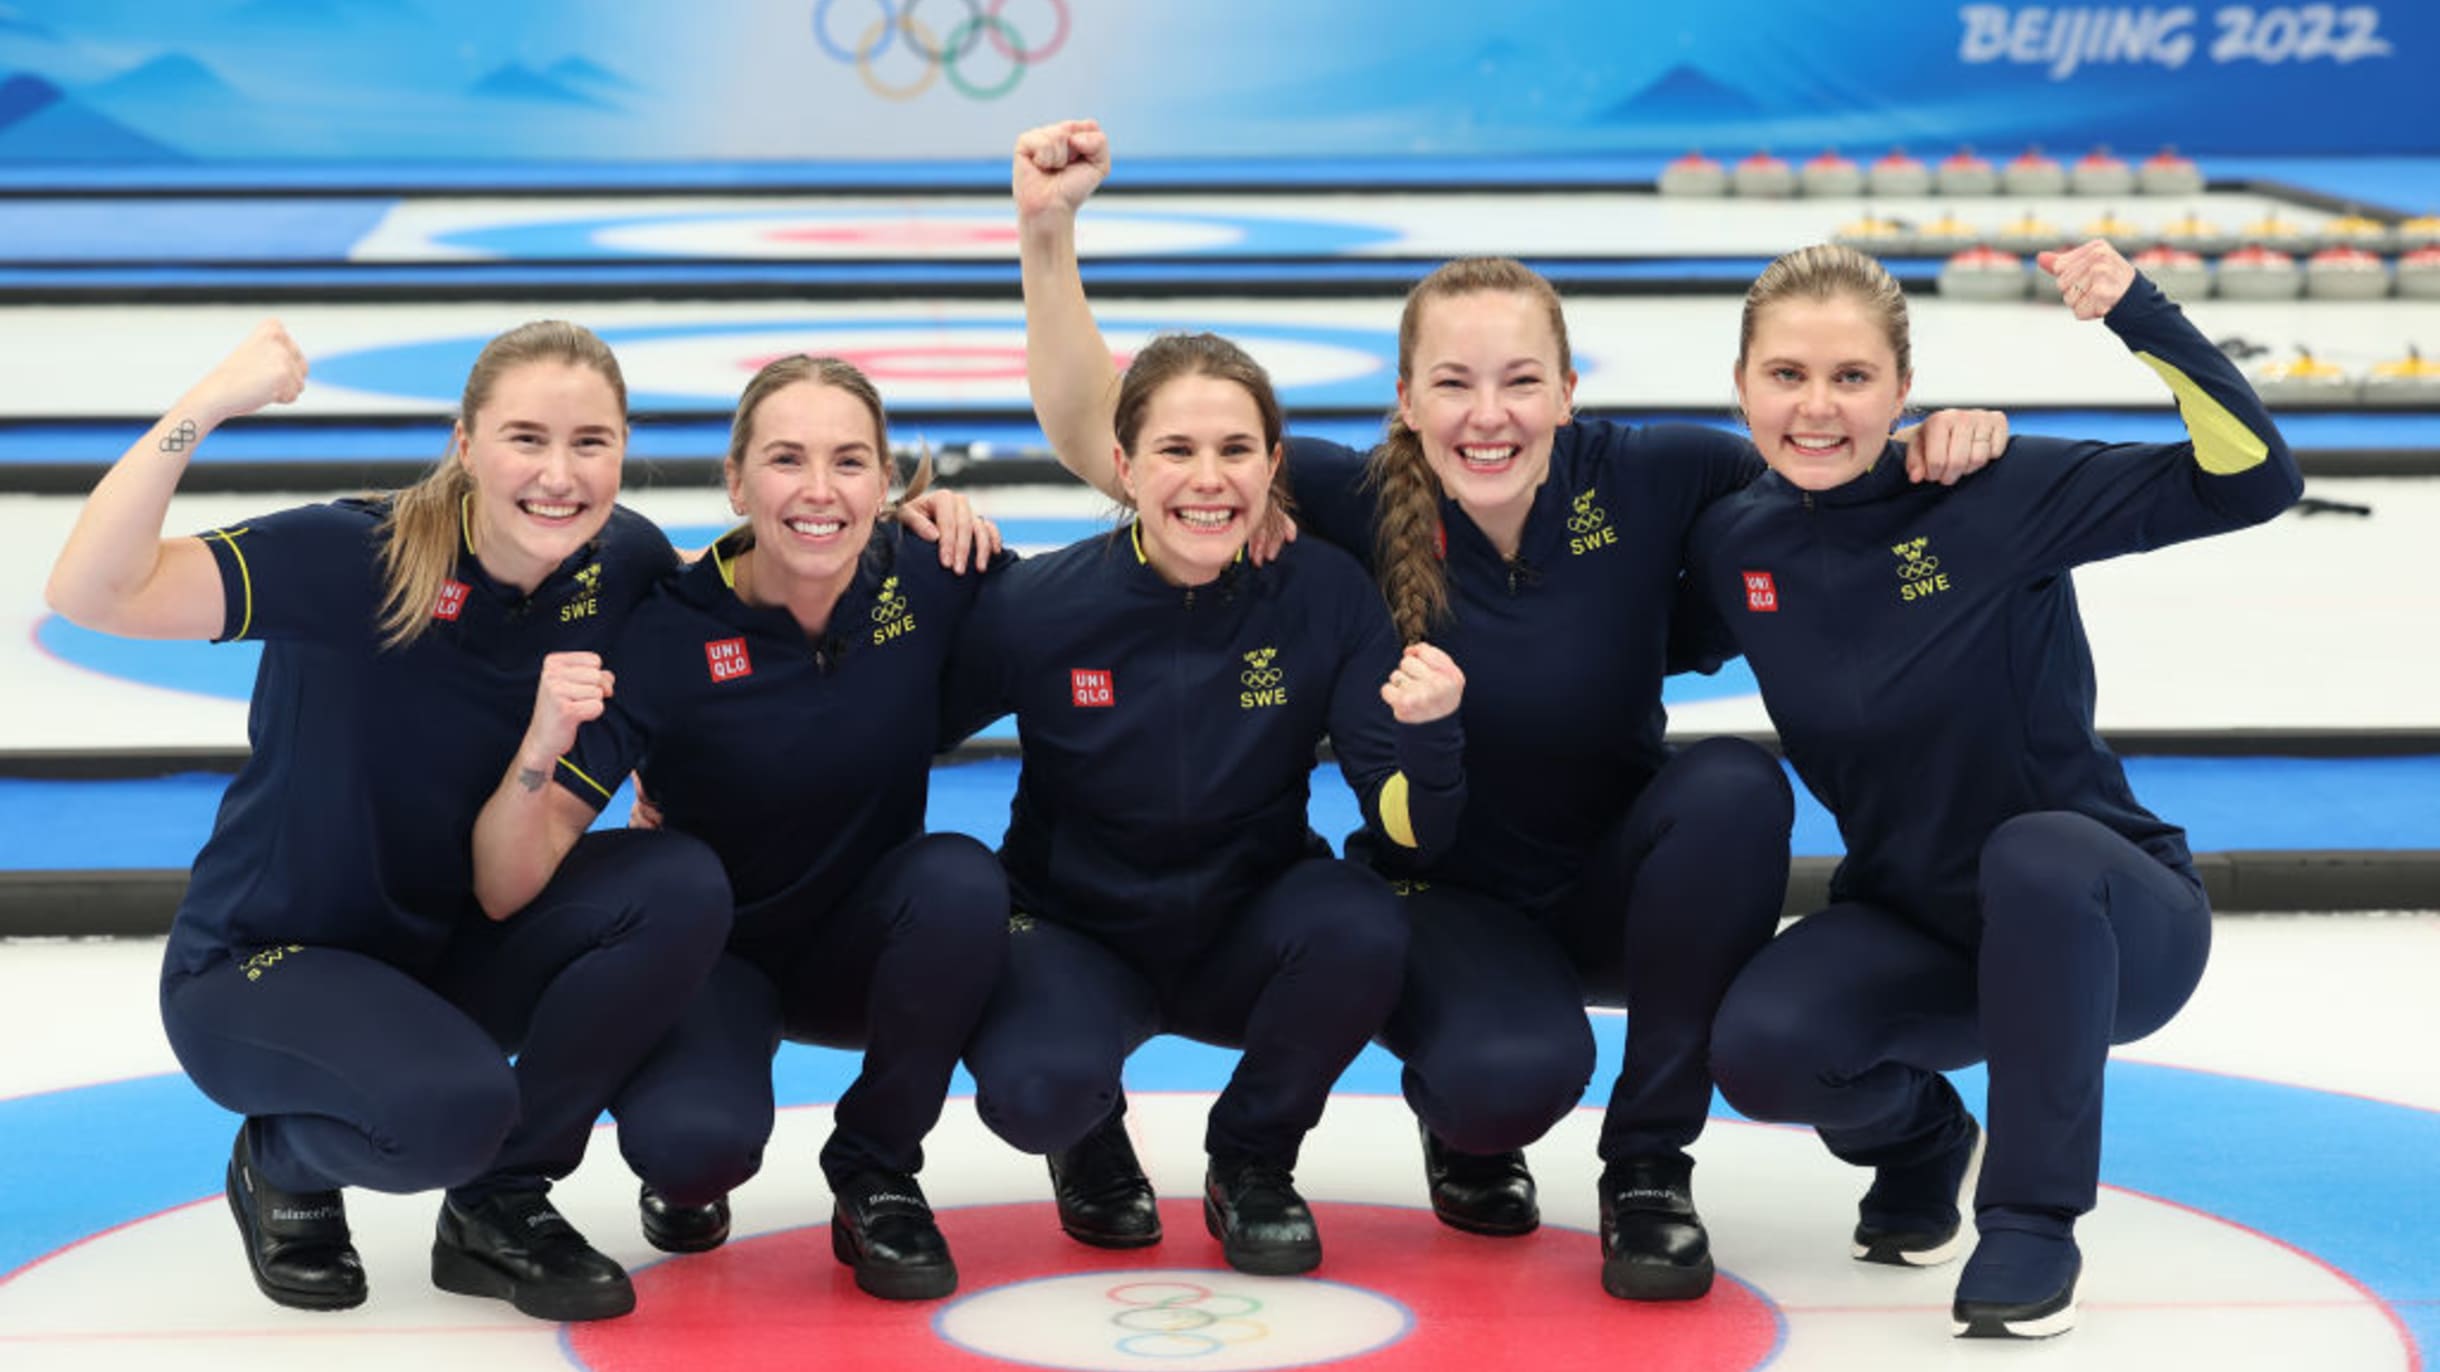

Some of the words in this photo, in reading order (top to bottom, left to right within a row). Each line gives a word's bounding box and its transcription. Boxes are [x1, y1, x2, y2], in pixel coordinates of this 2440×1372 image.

[1958, 5, 2196, 82] BEIJING
[2209, 5, 2395, 65] 2022
[1570, 526, 1618, 555] SWE
[1901, 573, 1950, 600] SWE
[437, 601, 457, 615] LO
[560, 599, 598, 622] SWE
[873, 614, 916, 645] SWE
[711, 642, 740, 660] UNI
[714, 656, 747, 677] QLO
[1076, 672, 1105, 688] UNI
[1077, 688, 1109, 704] QLO
[1240, 687, 1288, 708] SWE
